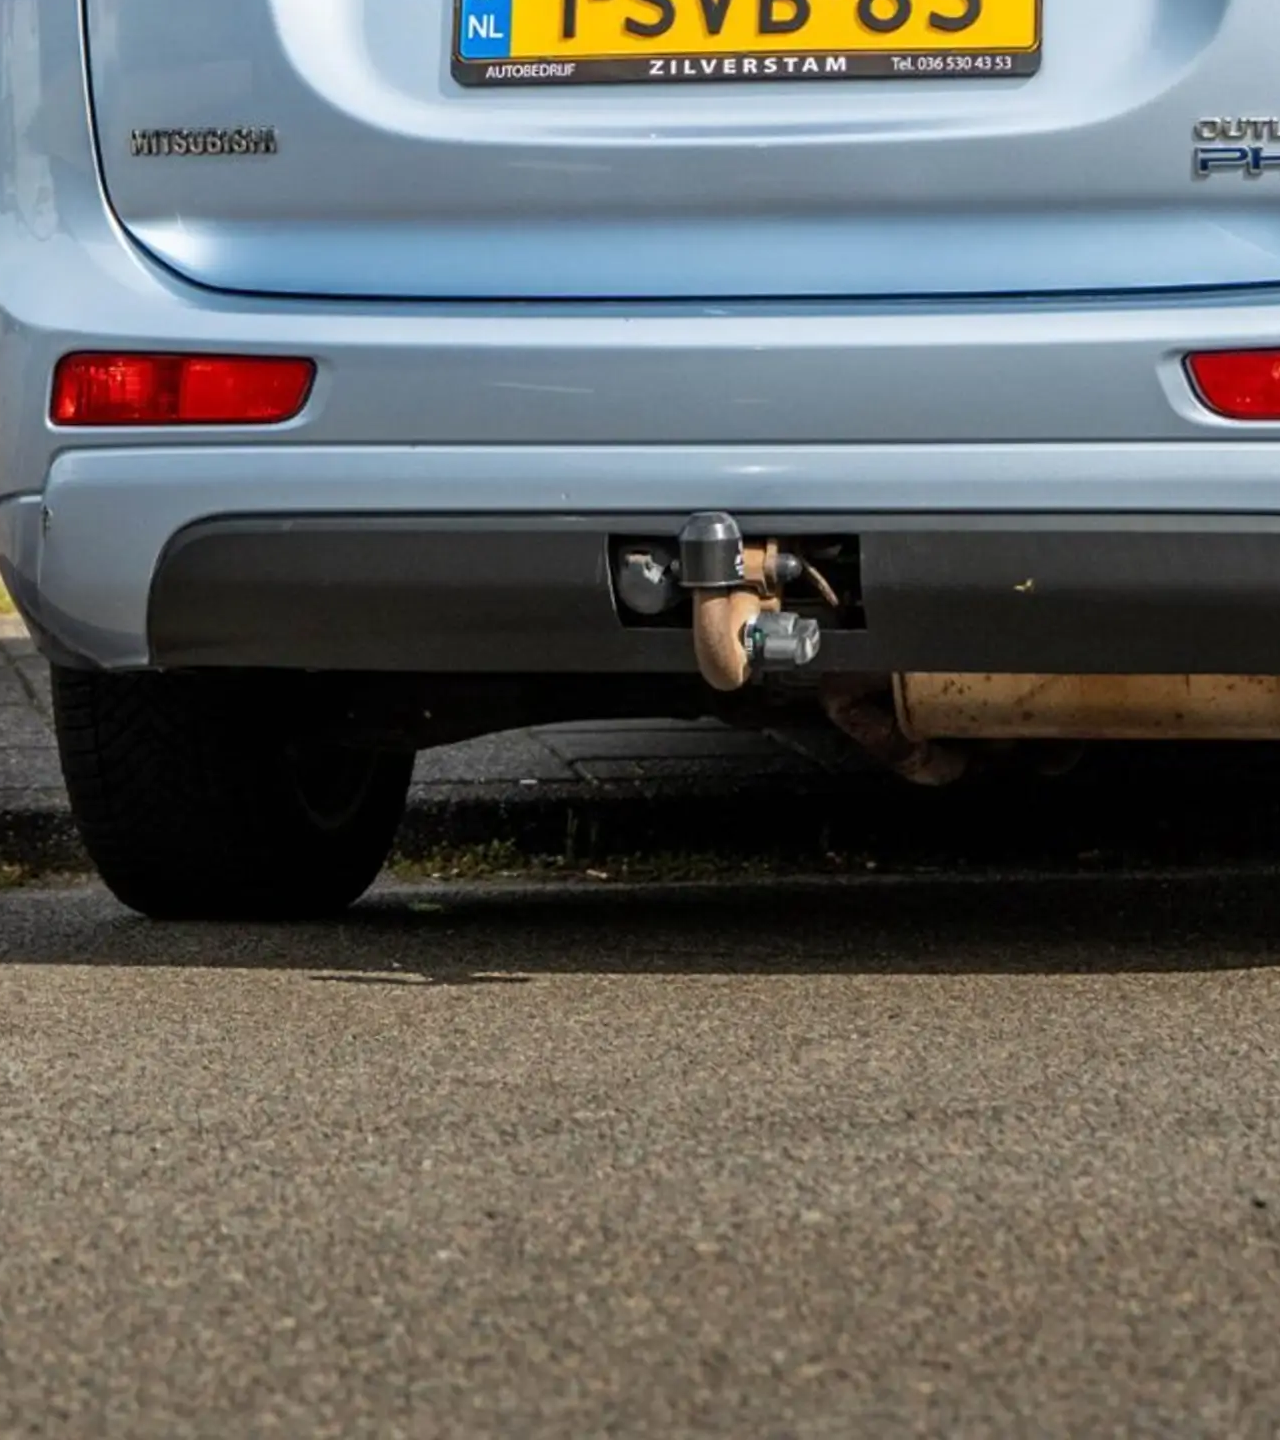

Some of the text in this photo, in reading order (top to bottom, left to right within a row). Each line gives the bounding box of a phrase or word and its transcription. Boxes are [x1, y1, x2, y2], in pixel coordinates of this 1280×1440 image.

[467, 14, 503, 40] NL
[485, 63, 576, 79] AUTOBEDRIJF
[648, 55, 848, 76] ZILVERSTAM
[917, 56, 944, 71] 036
[946, 56, 971, 71] 530
[974, 56, 992, 70] 43
[994, 56, 1012, 70] 53
[130, 127, 279, 155] MITSUBISHI
